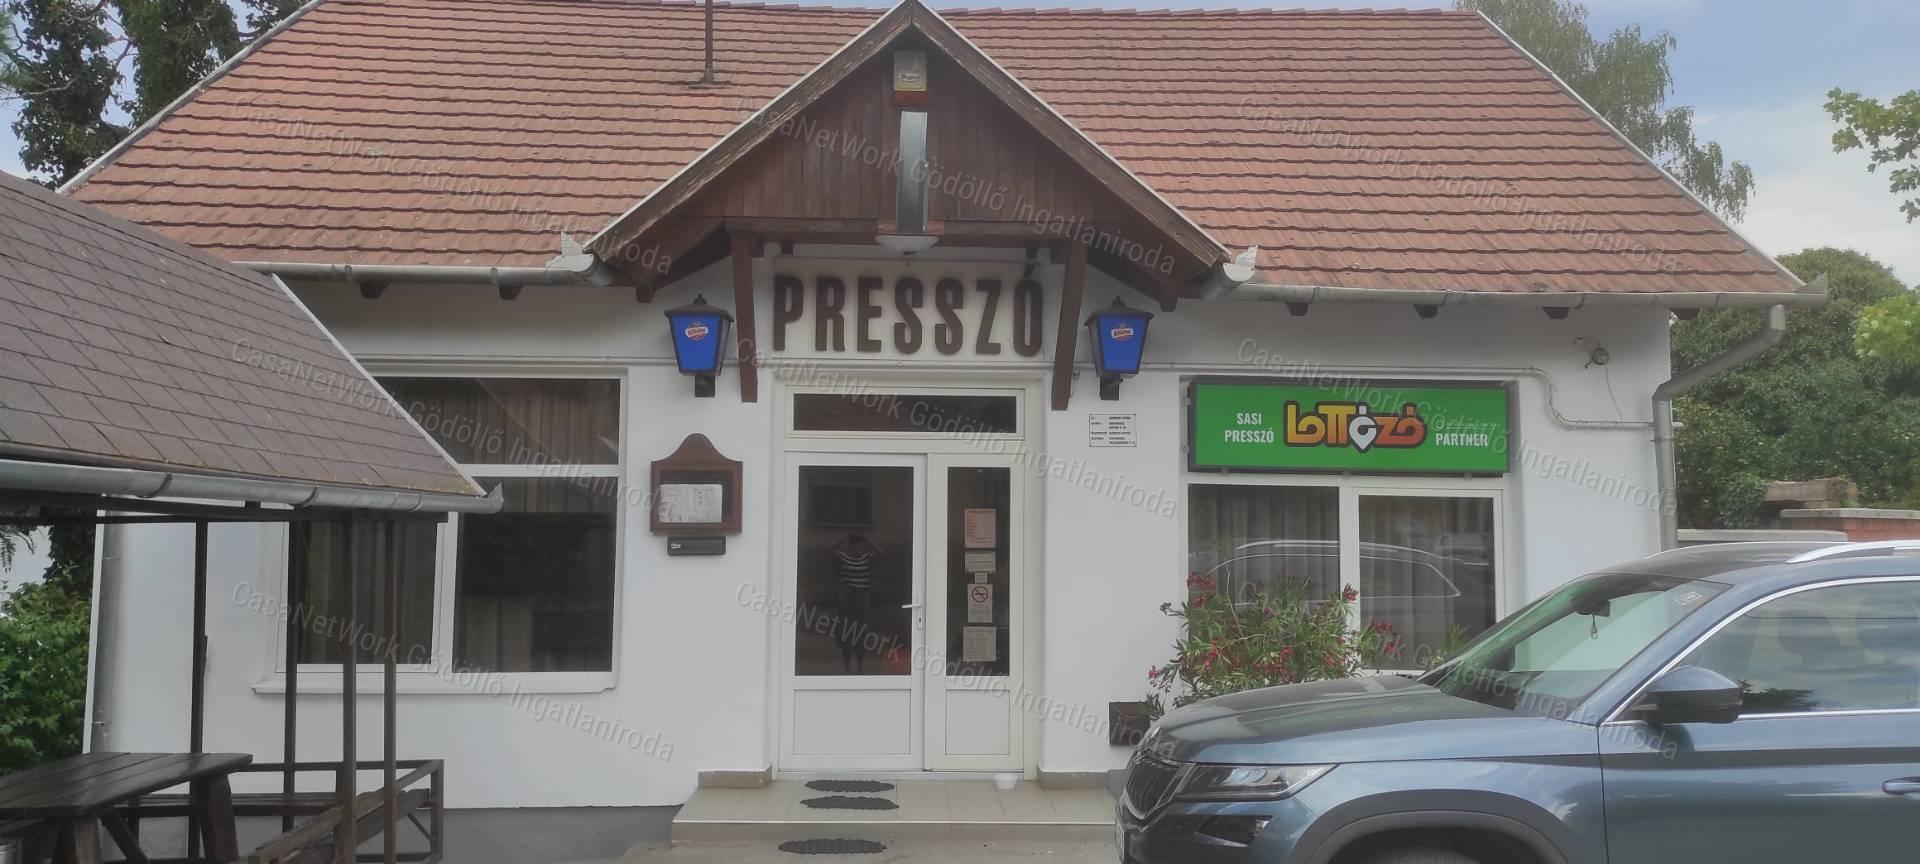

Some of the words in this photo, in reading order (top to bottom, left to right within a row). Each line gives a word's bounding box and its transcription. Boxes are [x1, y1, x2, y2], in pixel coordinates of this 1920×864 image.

[773, 264, 1043, 357] PRESSZÓ
[1236, 411, 1262, 425] SASI
[1224, 425, 1274, 444] PRESSZÓ
[1435, 433, 1489, 447] PARTNER
